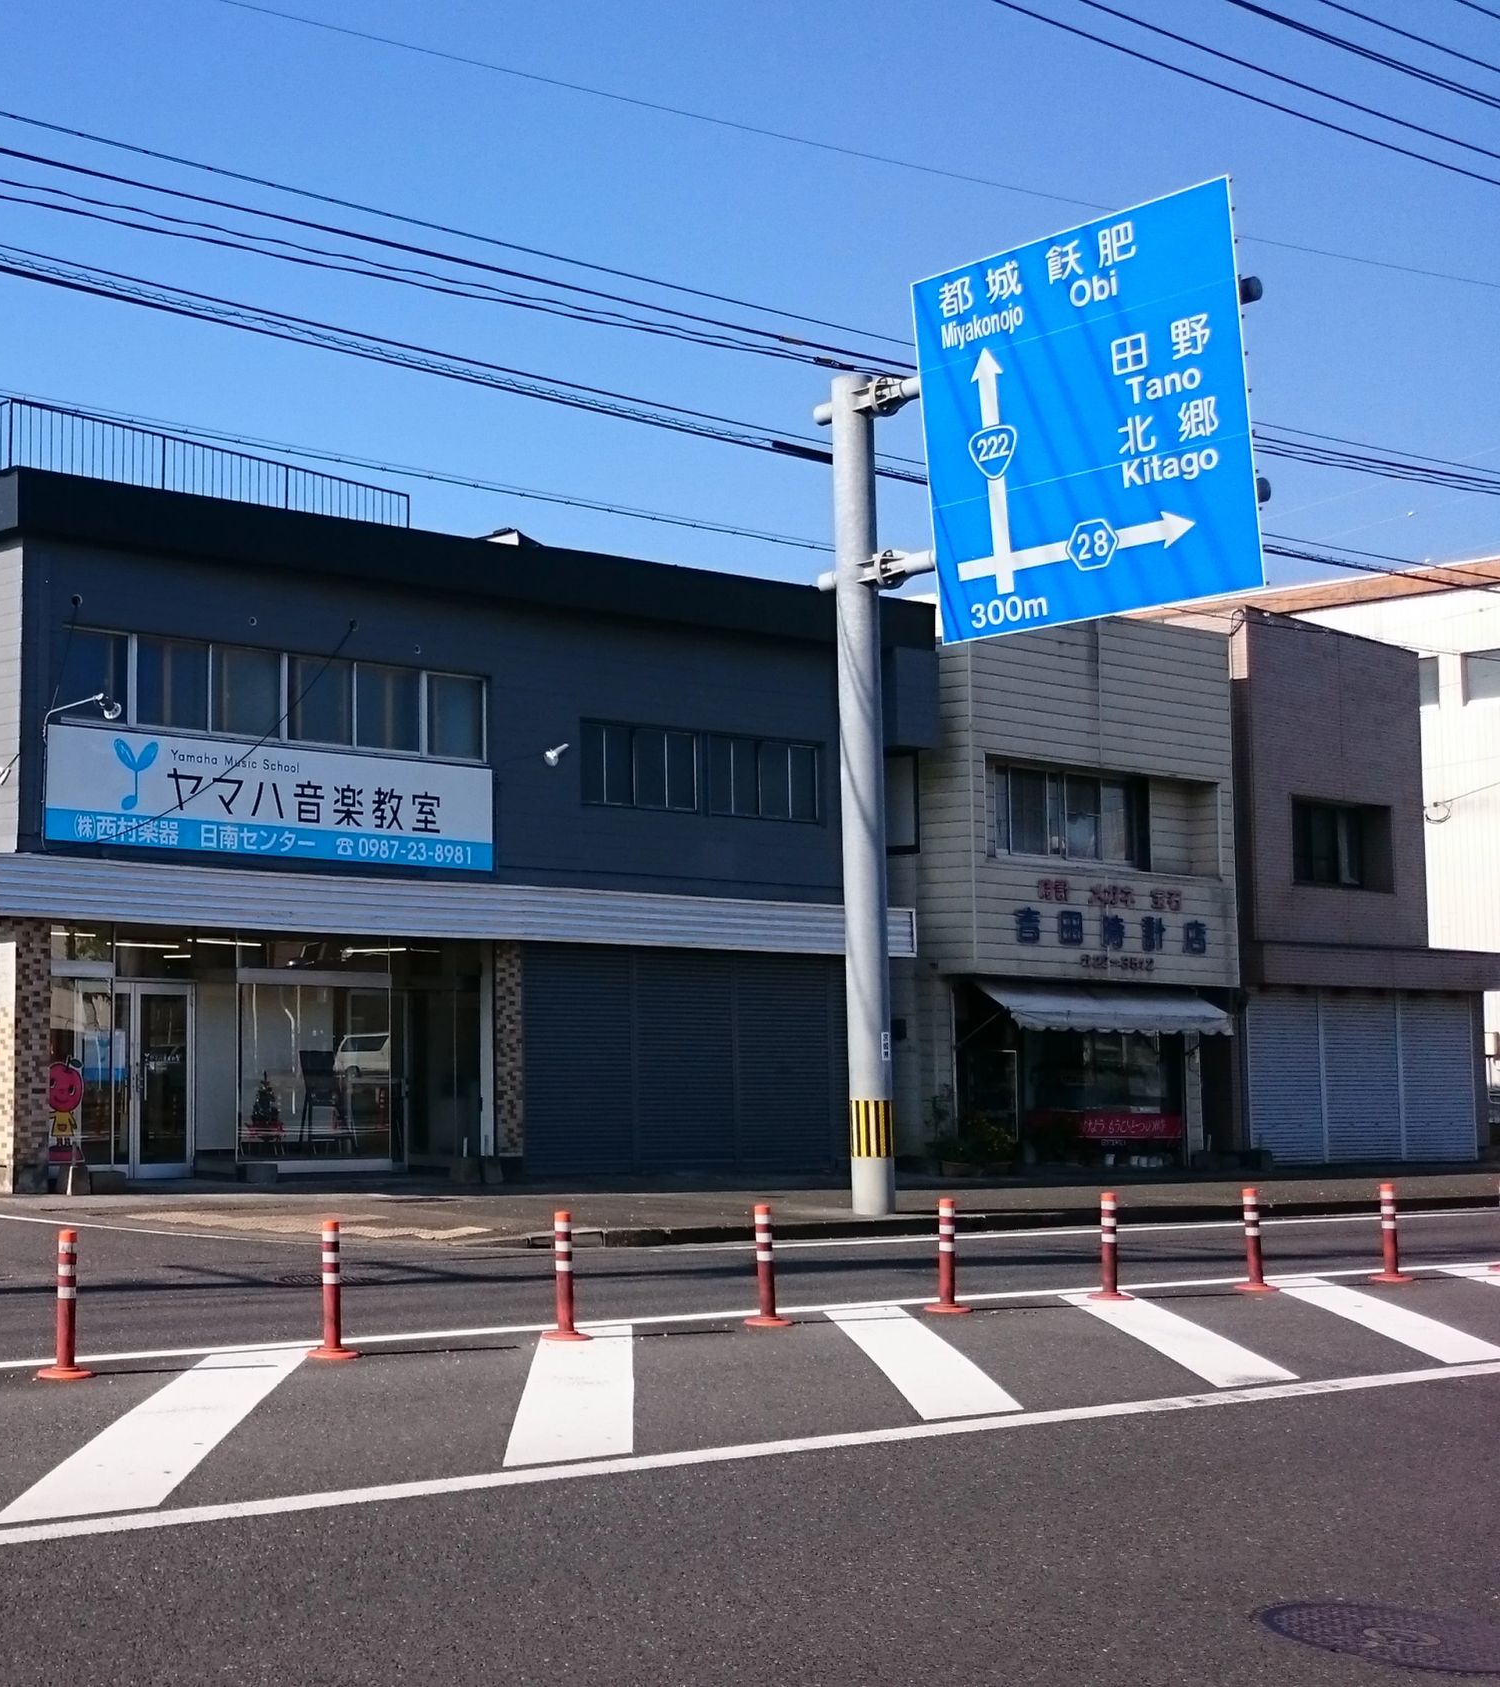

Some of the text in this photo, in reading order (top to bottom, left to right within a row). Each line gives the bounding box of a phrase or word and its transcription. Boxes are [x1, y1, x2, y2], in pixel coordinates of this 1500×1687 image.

[1045, 221, 1137, 285] 飫肥
[938, 260, 1023, 318] 都城
[1070, 270, 1118, 308] Obi
[940, 303, 1023, 350] Miyakonojo
[1111, 313, 1210, 376] 田野
[1125, 367, 1201, 404] Tano
[1117, 396, 1219, 455] 北郷
[976, 432, 1010, 463] 222
[1122, 448, 1218, 488] Kitago
[1076, 529, 1108, 560] 28
[970, 595, 1049, 629] 300m
[170, 749, 301, 774] Yamaha Music School
[167, 767, 441, 834] ヤマハ音楽教室
[200, 823, 316, 852] 日南センター
[357, 838, 472, 865] 0987-23-8981
[1012, 906, 1207, 955] 吉田時計店
